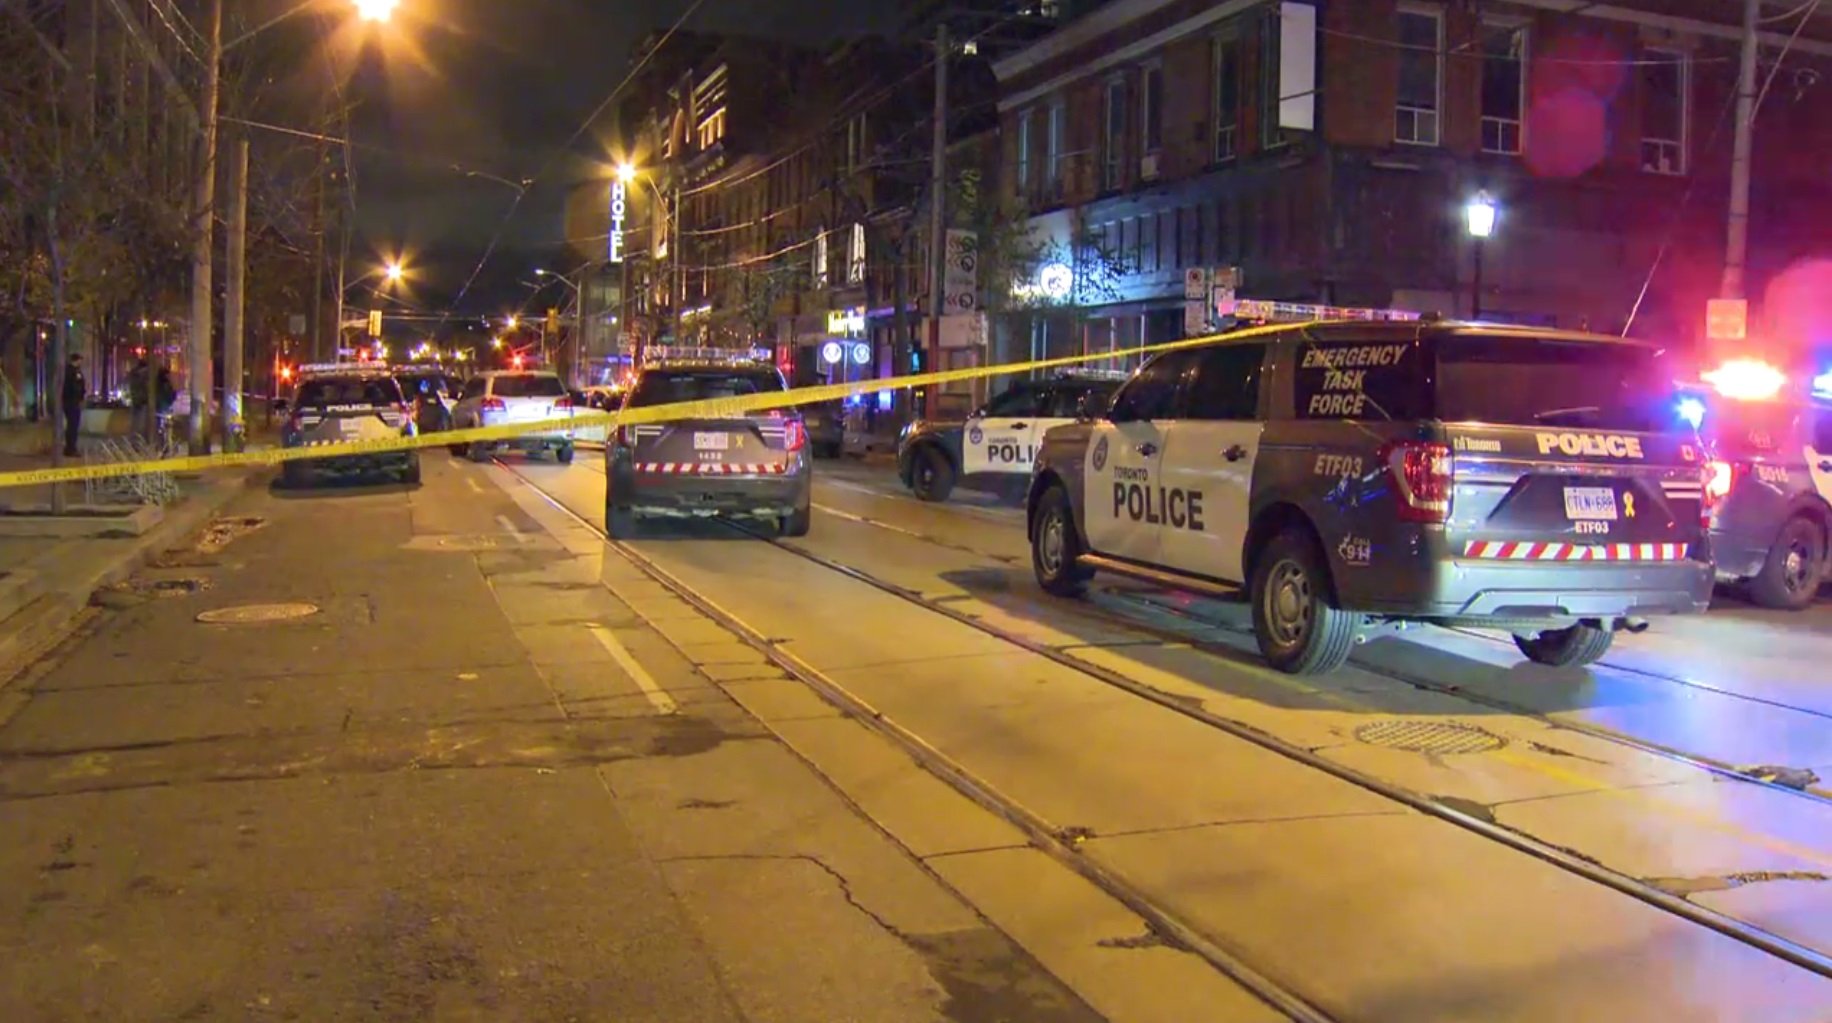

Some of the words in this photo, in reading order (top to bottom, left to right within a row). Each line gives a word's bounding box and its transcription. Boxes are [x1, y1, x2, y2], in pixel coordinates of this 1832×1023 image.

[611, 182, 625, 262] HOTEL
[1301, 344, 1408, 368] EMERGENCY
[1323, 370, 1367, 390] TASK
[326, 403, 373, 413] POLICE
[1308, 394, 1365, 415] FORCE
[988, 445, 1037, 463] POLI
[1535, 432, 1644, 458] POLICE
[1113, 466, 1149, 481] TORONTO
[1314, 454, 1363, 479] ETF03
[1113, 482, 1205, 531] POLICE
[1575, 521, 1609, 534] ETF03
